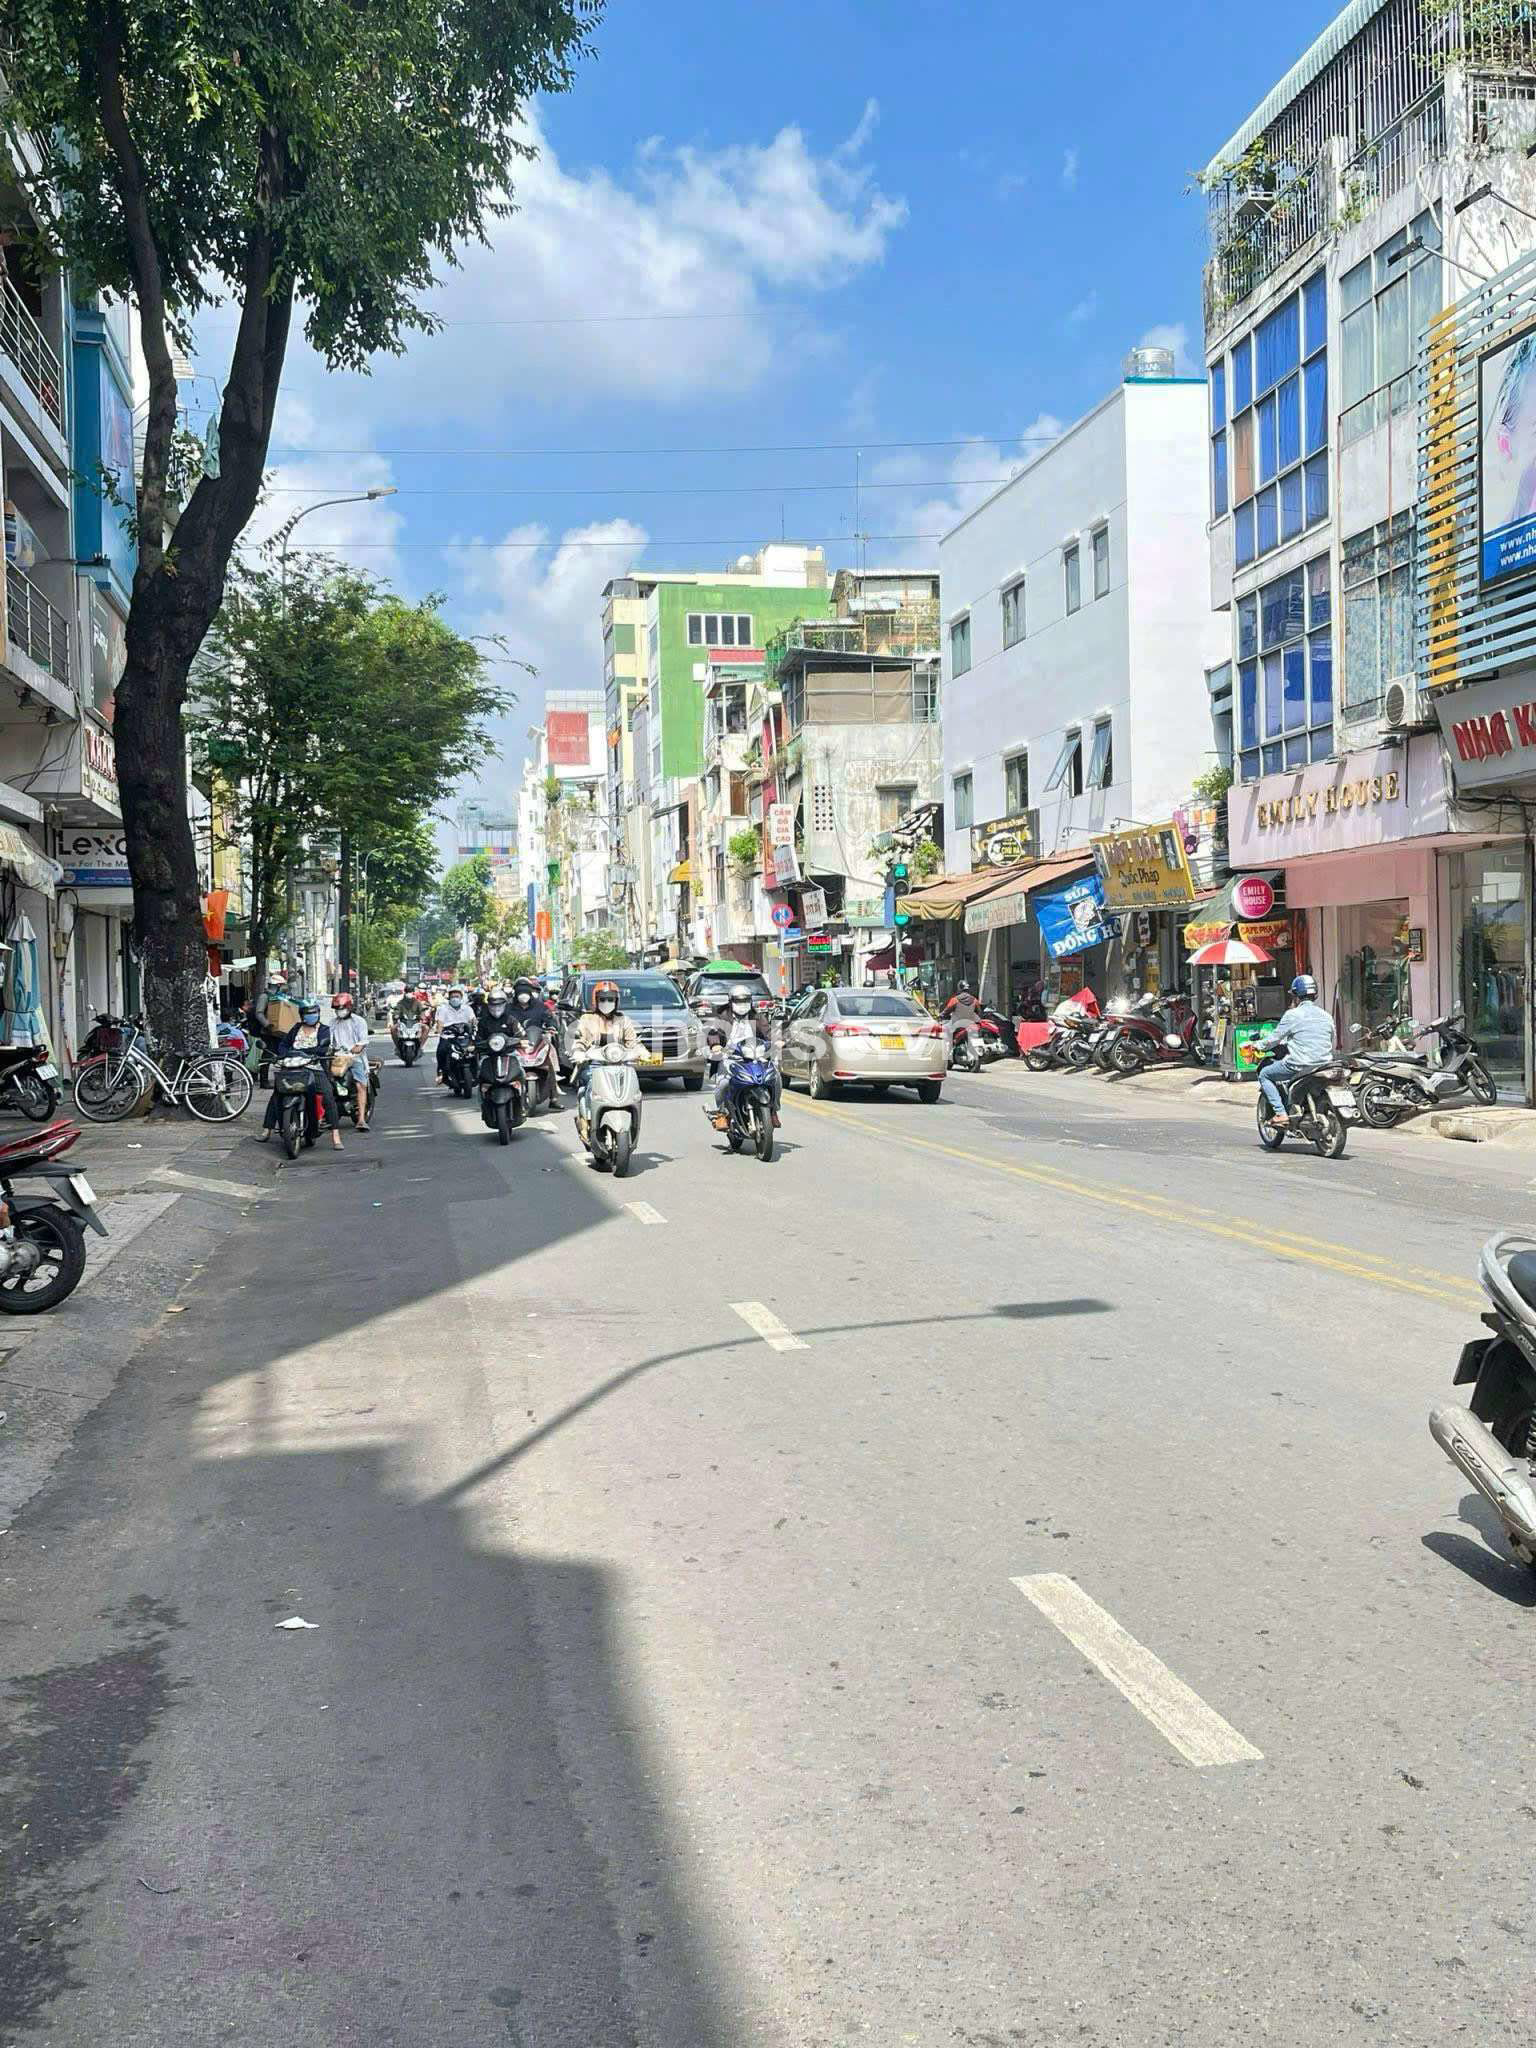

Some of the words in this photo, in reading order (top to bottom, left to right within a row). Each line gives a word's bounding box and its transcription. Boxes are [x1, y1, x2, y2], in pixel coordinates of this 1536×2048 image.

[1257, 791, 1318, 828] EMILY
[1325, 772, 1400, 813] HOUSE
[1243, 886, 1265, 896] EMILY
[1244, 896, 1267, 905] HOUSE
